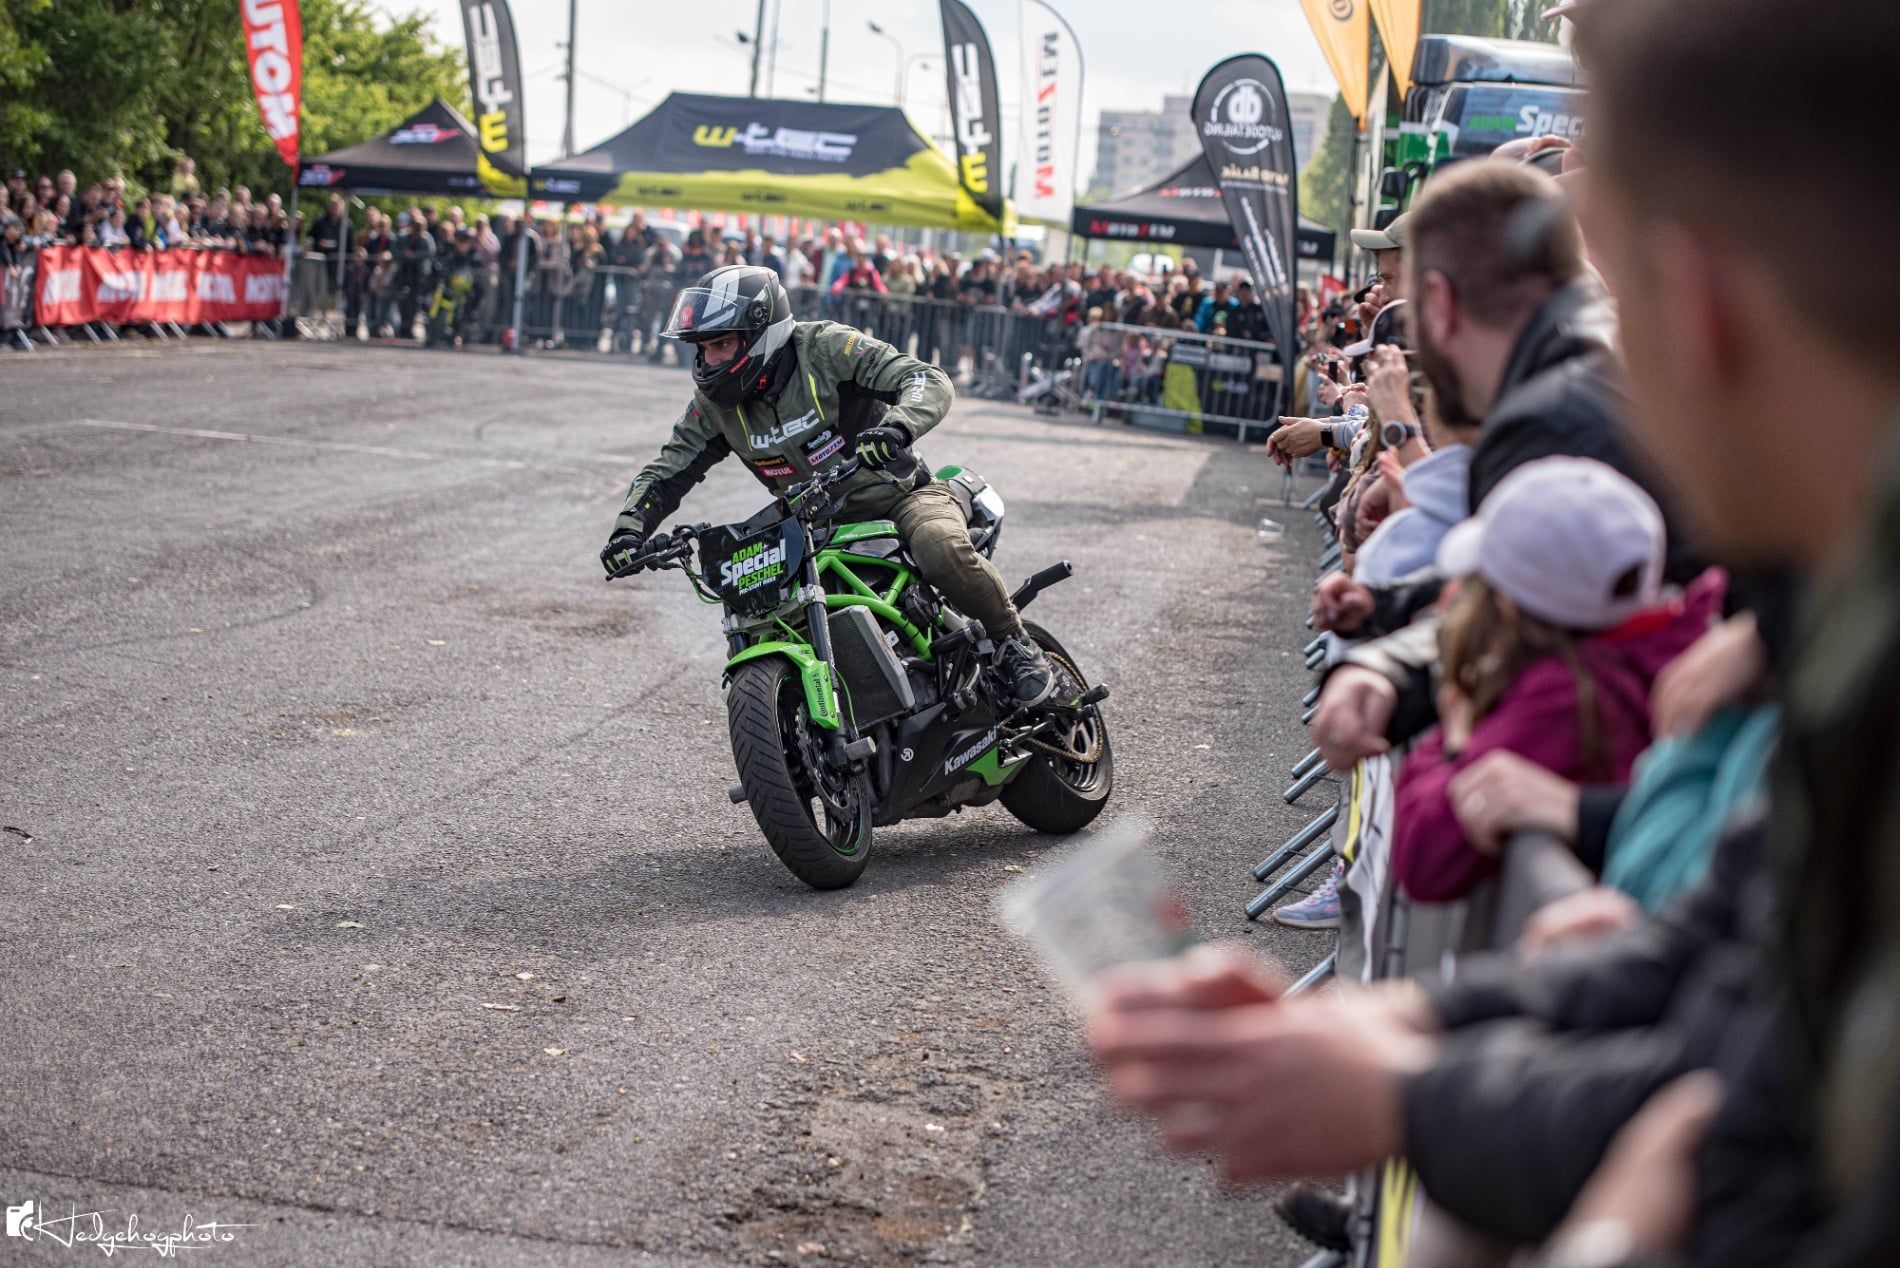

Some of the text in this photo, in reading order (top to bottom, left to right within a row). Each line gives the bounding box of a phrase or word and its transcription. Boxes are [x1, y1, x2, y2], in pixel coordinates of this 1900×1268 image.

[1515, 104, 1586, 138] Spec
[720, 538, 787, 587] Special
[732, 541, 764, 565] ADAM
[738, 562, 784, 590] PESCHEL
[812, 678, 829, 717] Continental
[944, 725, 998, 776] Kawasaki
